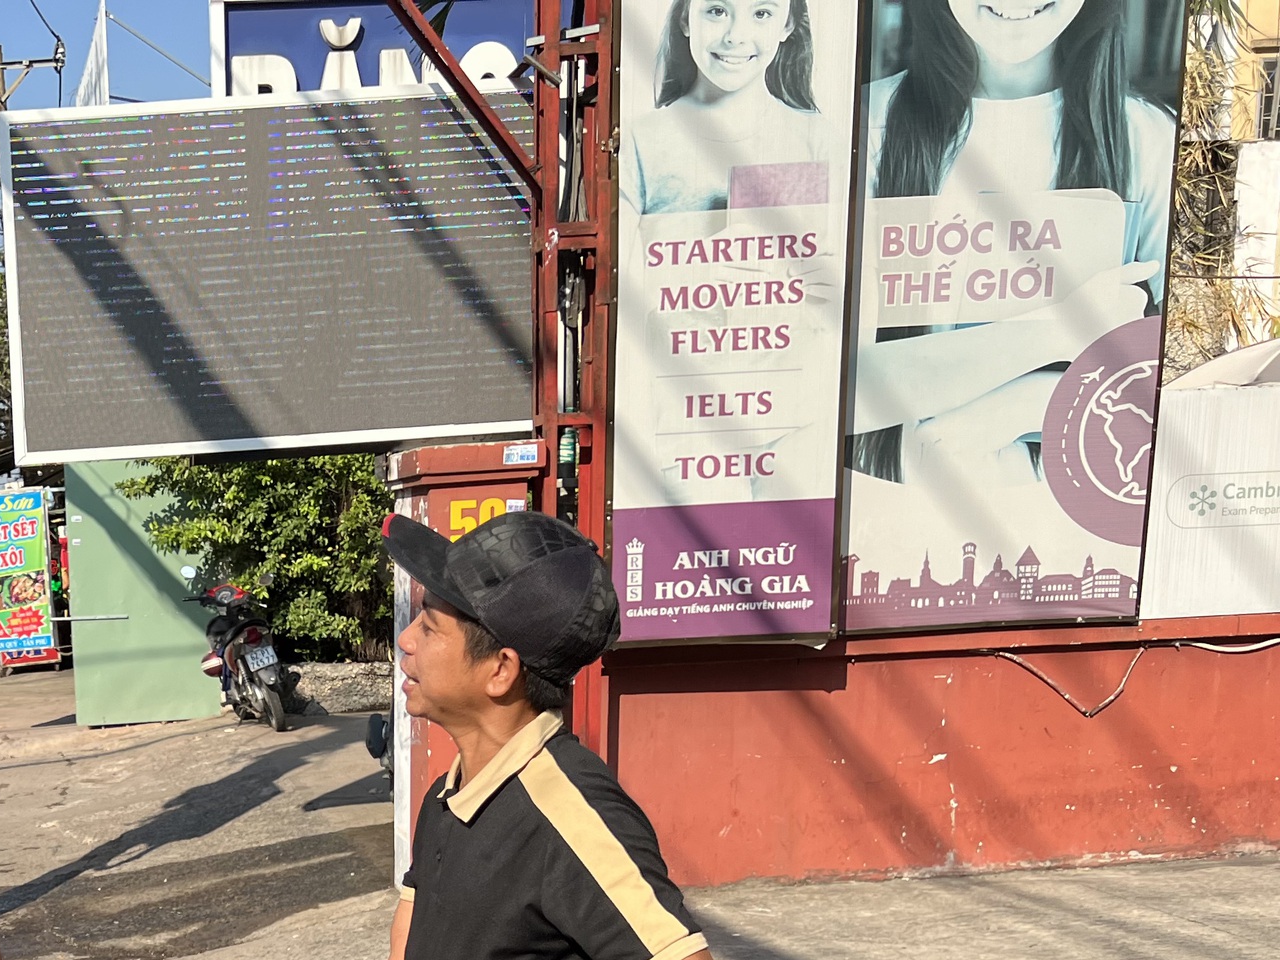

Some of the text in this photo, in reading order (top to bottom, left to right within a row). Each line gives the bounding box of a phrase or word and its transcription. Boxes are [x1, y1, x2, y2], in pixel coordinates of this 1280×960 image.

[881, 213, 1062, 258] BƯỚC RA
[647, 232, 818, 268] STARTERS
[659, 278, 804, 312] MOVERS
[881, 257, 1055, 306] THẾ GIỚI
[670, 324, 791, 355] FLYERS
[685, 391, 773, 419] IELTS
[674, 452, 776, 480] TOEIC
[0, 496, 34, 512] Sơn
[1221, 507, 1247, 517] Exam
[0, 546, 24, 568] XÔI
[672, 542, 797, 570] ANH NGỮ
[654, 573, 811, 600] HOÀNG GIA
[626, 597, 814, 618] GIẢNG DẠY TIẾNG ANH CHUYÊN NGHIỆP
